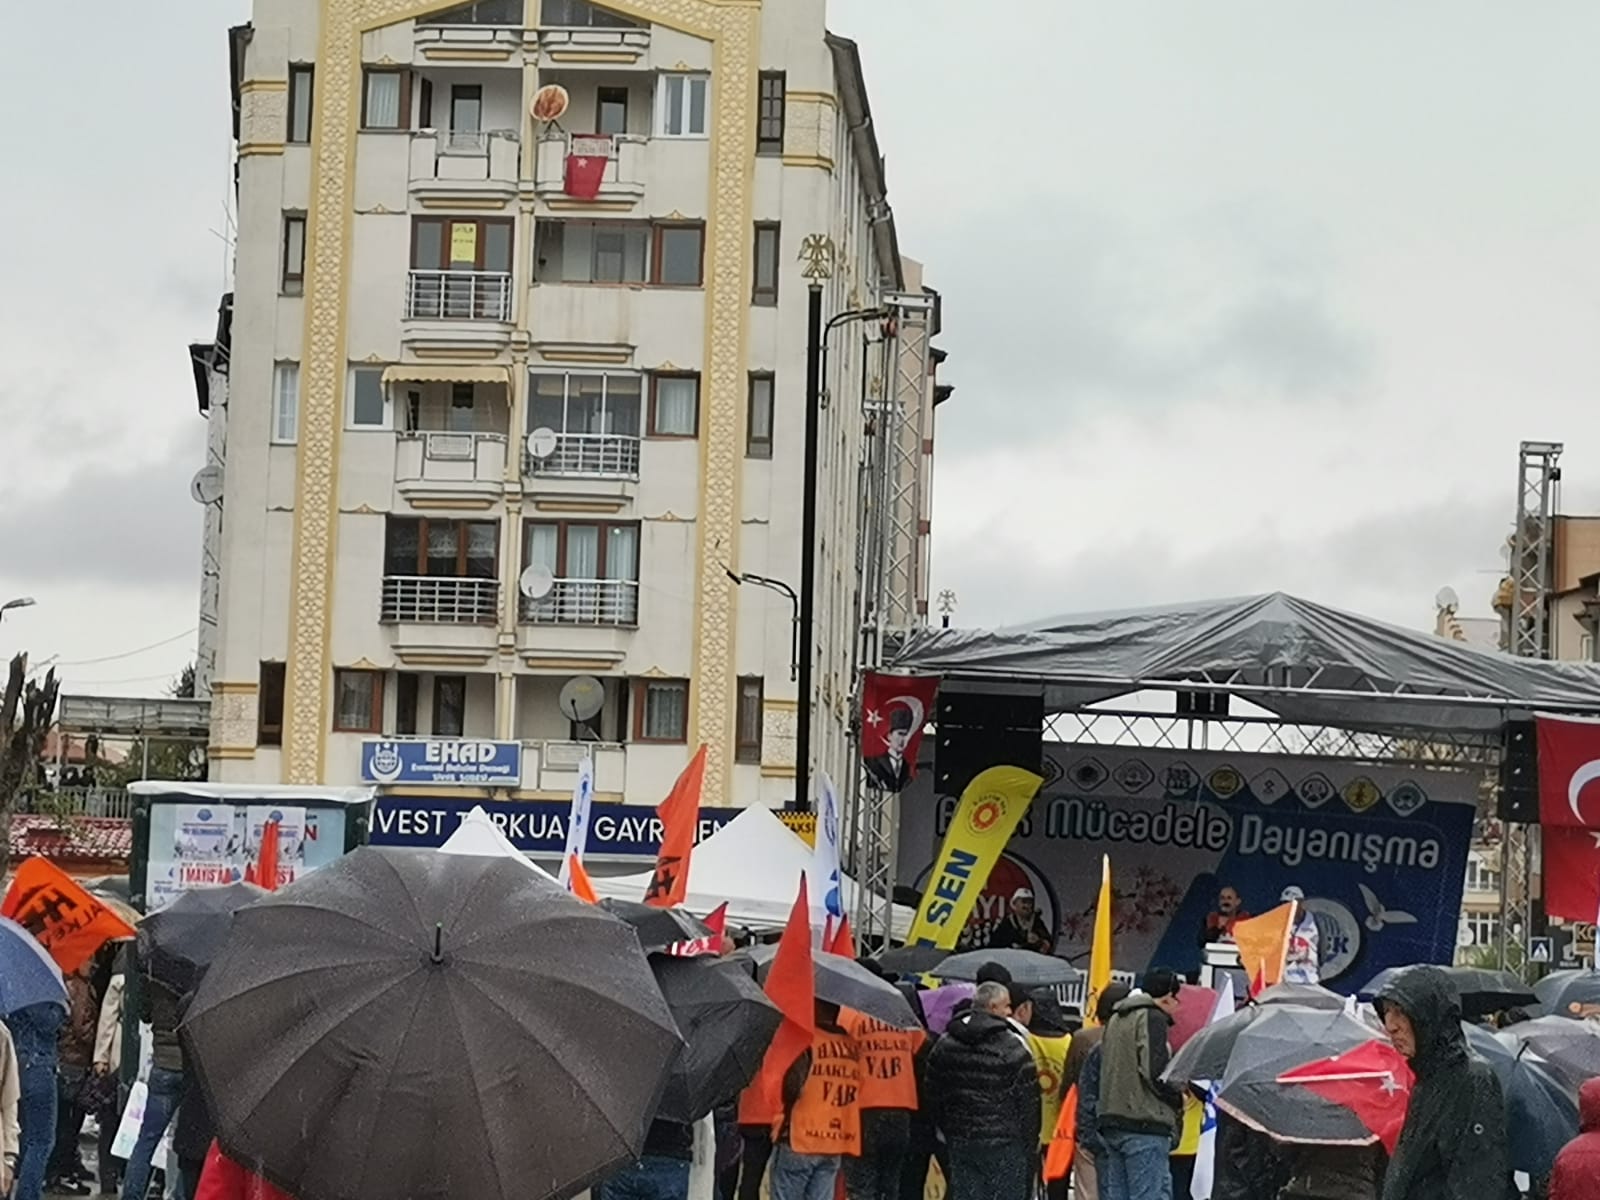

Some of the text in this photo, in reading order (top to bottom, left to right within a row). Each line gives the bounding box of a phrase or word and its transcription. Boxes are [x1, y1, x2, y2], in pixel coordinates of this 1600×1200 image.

[426, 742, 497, 764] EHAD
[369, 808, 447, 836] VEST
[1046, 799, 1233, 850] Mücadele
[1239, 814, 1440, 873] Dayanışma
[926, 848, 978, 928] SEN
[823, 1081, 858, 1107] VAR
